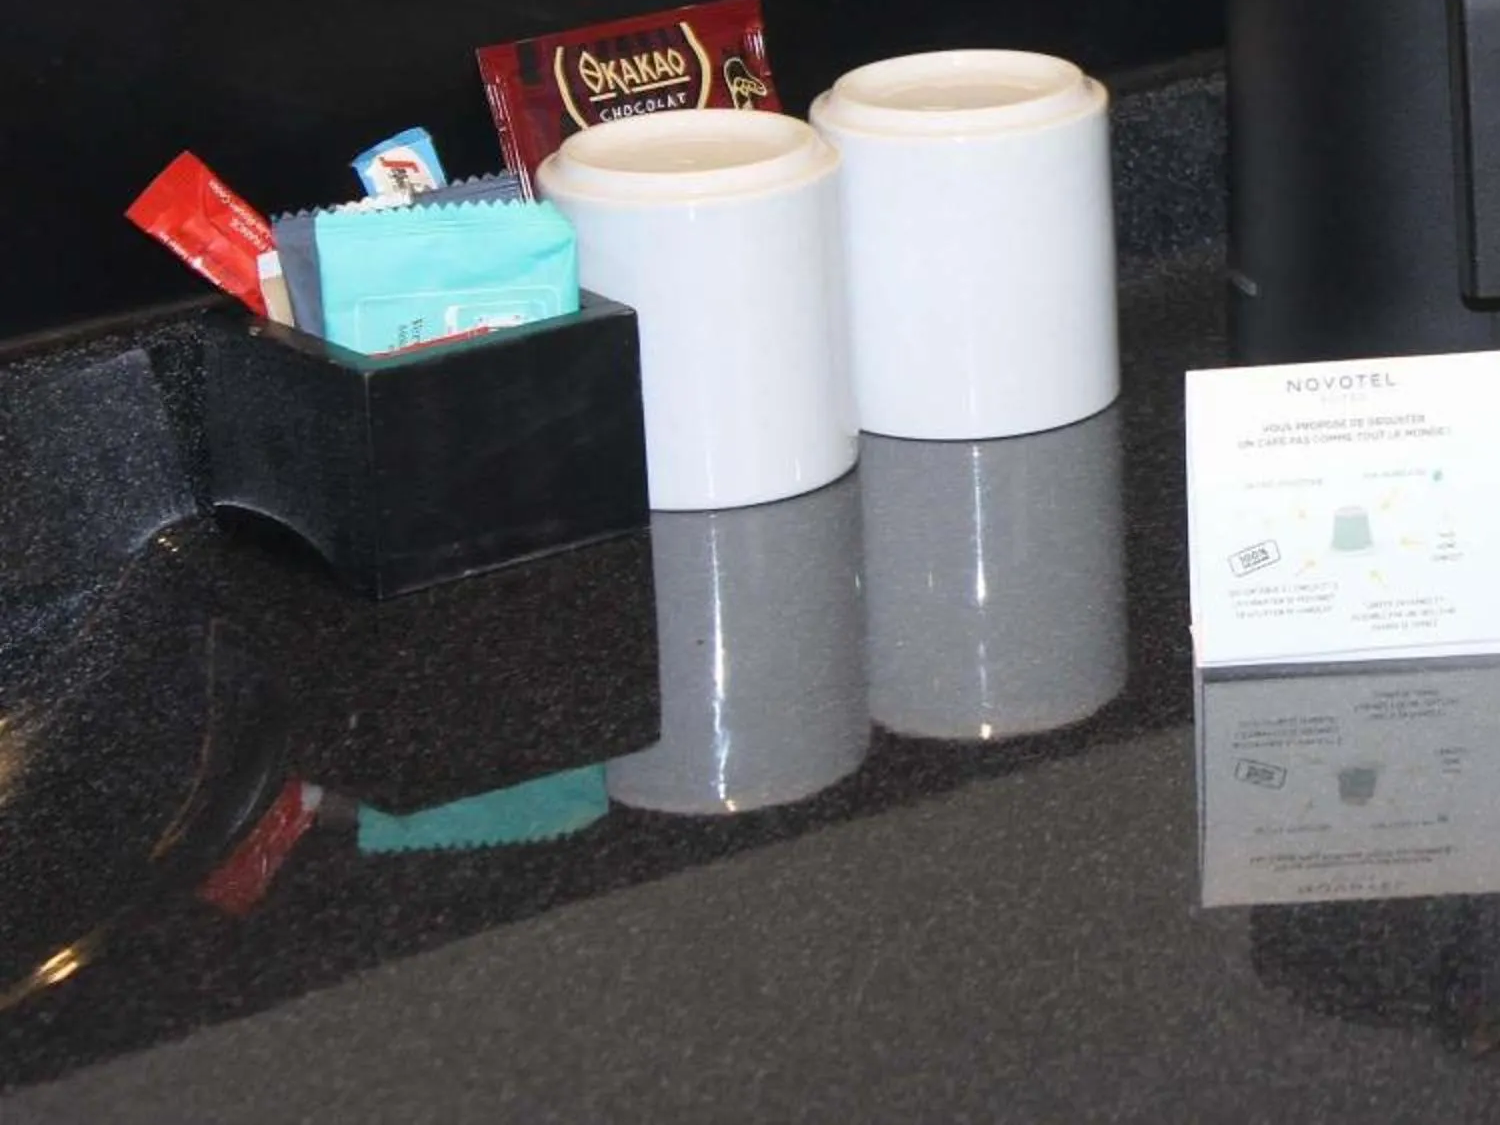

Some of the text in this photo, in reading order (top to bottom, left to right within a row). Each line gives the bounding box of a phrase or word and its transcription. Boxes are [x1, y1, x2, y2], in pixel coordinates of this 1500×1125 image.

[599, 92, 687, 123] CHOCOLAT
[1286, 372, 1397, 393] NOVOTEL
[1263, 422, 1292, 433] VOUS
[1290, 435, 1310, 446] PAS
[1313, 432, 1352, 445] COMME
[1357, 430, 1385, 442] TOUT
